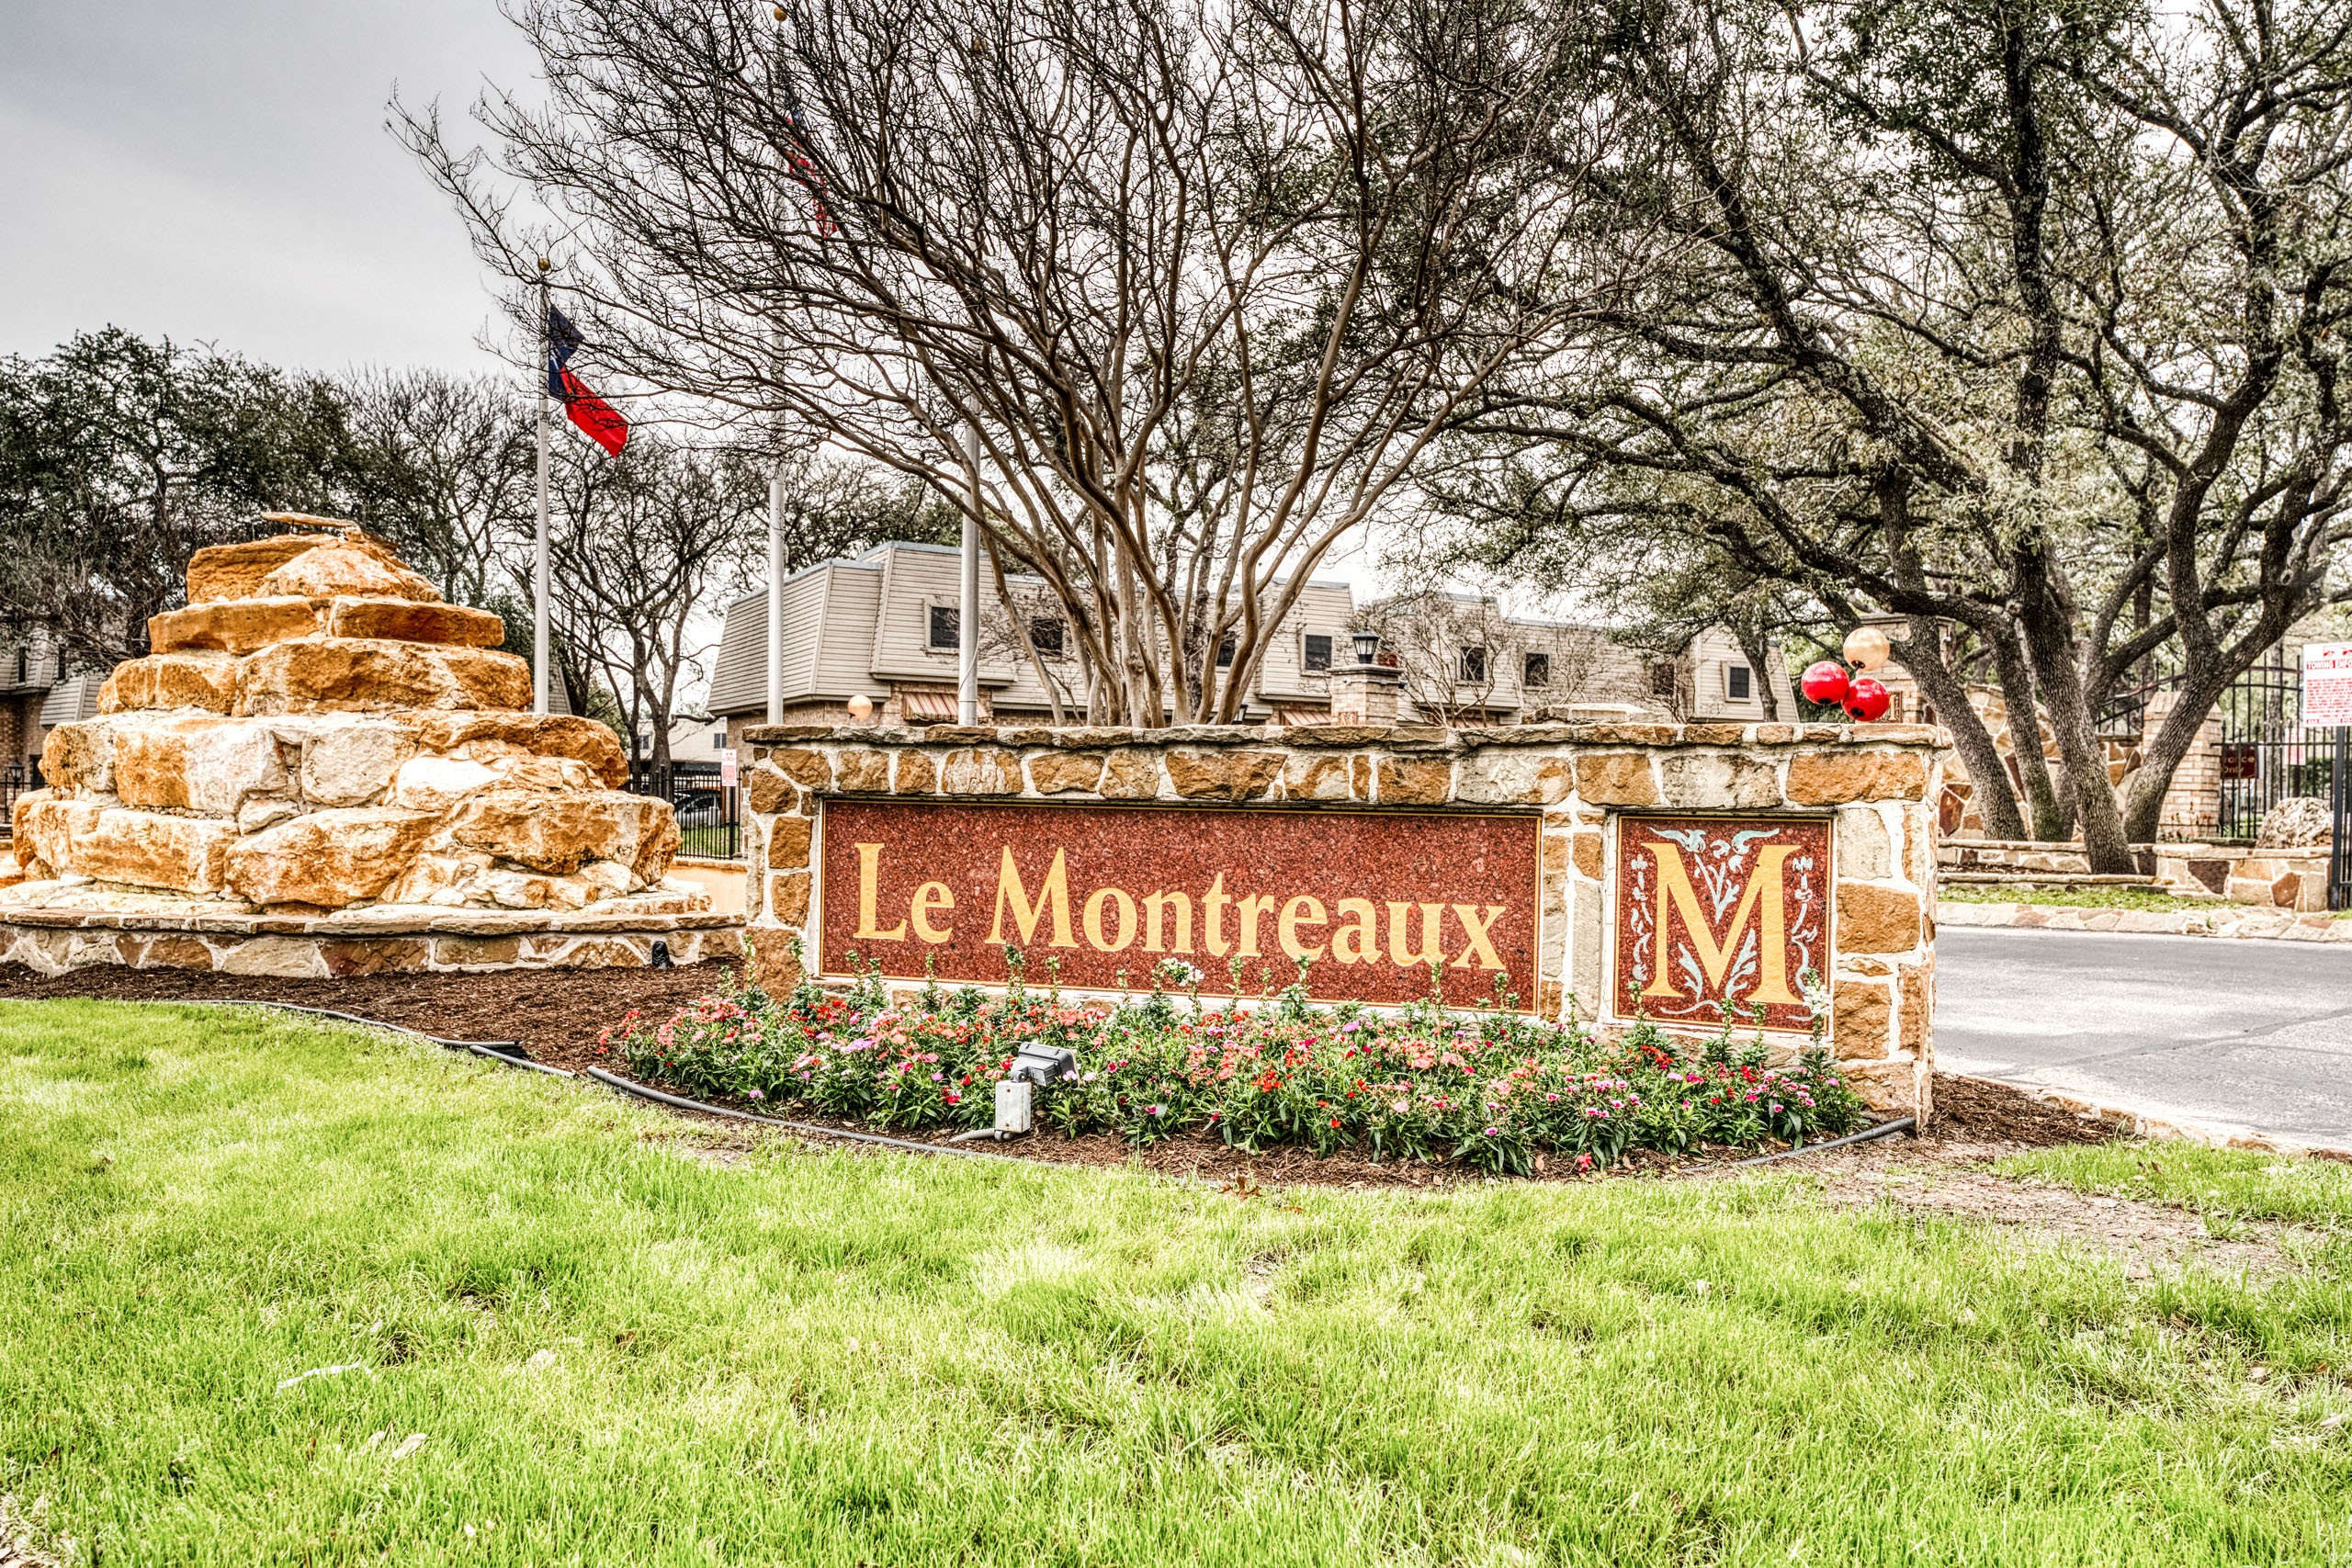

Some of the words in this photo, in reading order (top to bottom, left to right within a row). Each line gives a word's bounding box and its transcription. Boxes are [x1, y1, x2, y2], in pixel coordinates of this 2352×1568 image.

[853, 842, 955, 944] Le
[984, 845, 1507, 971] Montreaux
[1641, 842, 1804, 1005] M
